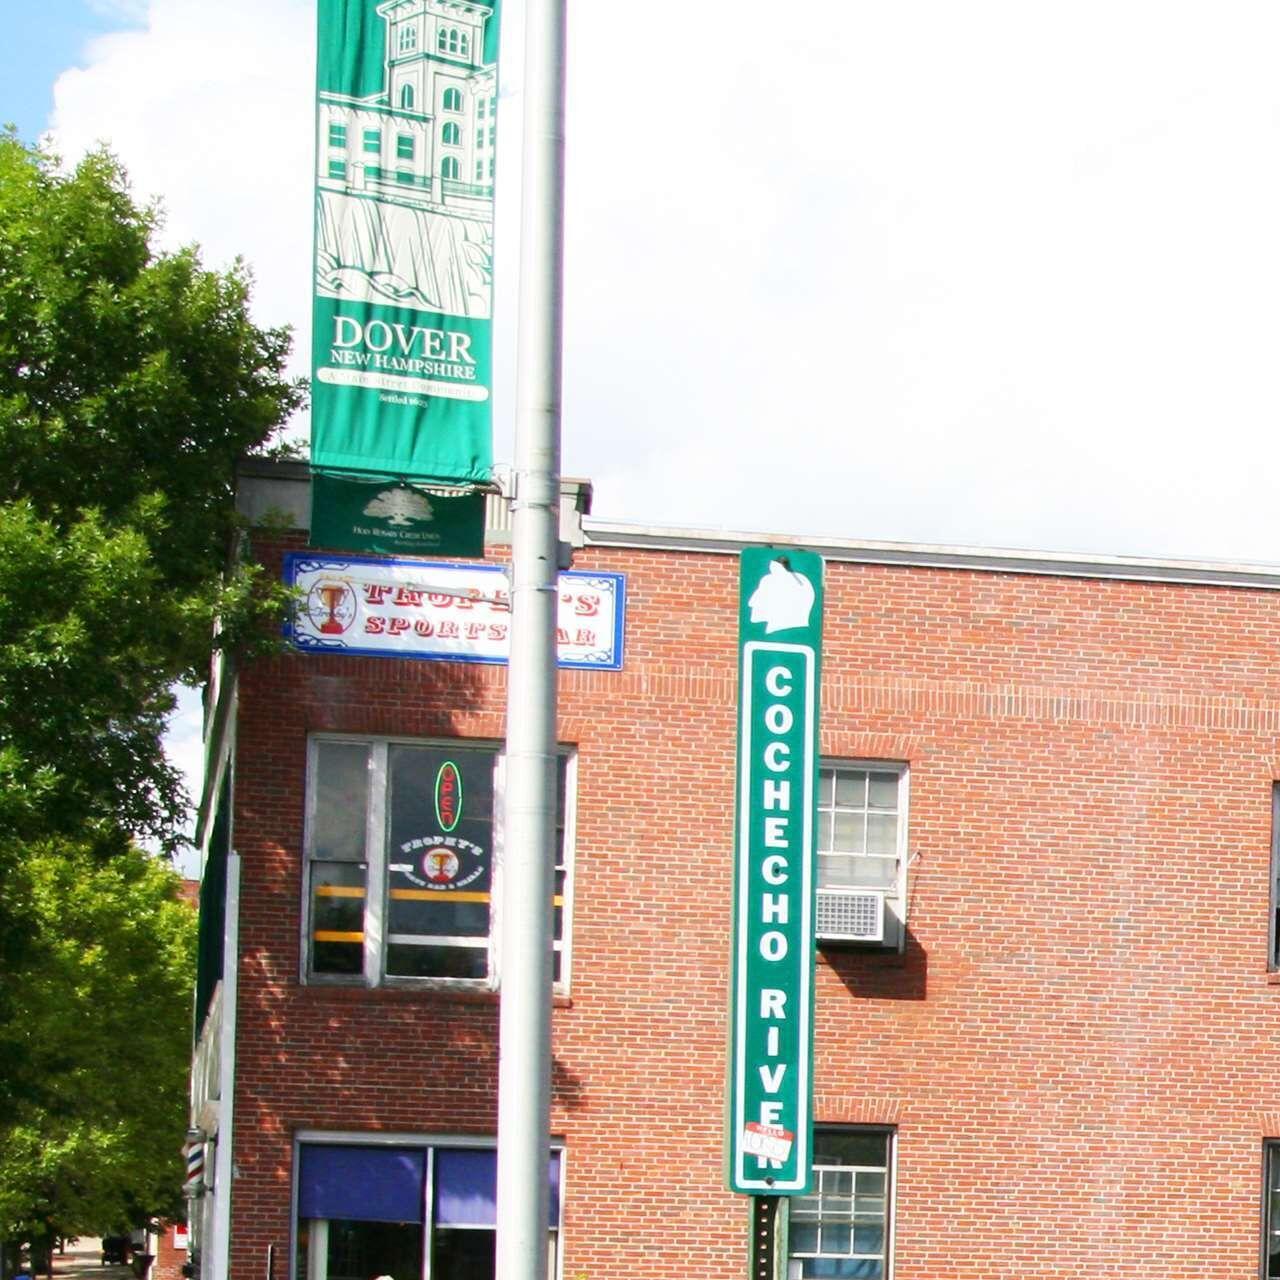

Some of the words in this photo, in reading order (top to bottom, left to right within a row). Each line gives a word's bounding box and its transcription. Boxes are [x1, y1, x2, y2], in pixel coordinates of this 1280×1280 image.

[330, 349, 371, 366] NEW
[374, 353, 476, 380] HAMPSHIRE
[333, 315, 477, 365] DOVER
[365, 615, 508, 641] SPORTS
[440, 766, 455, 825] OPEN
[757, 666, 794, 963] COCHECHO
